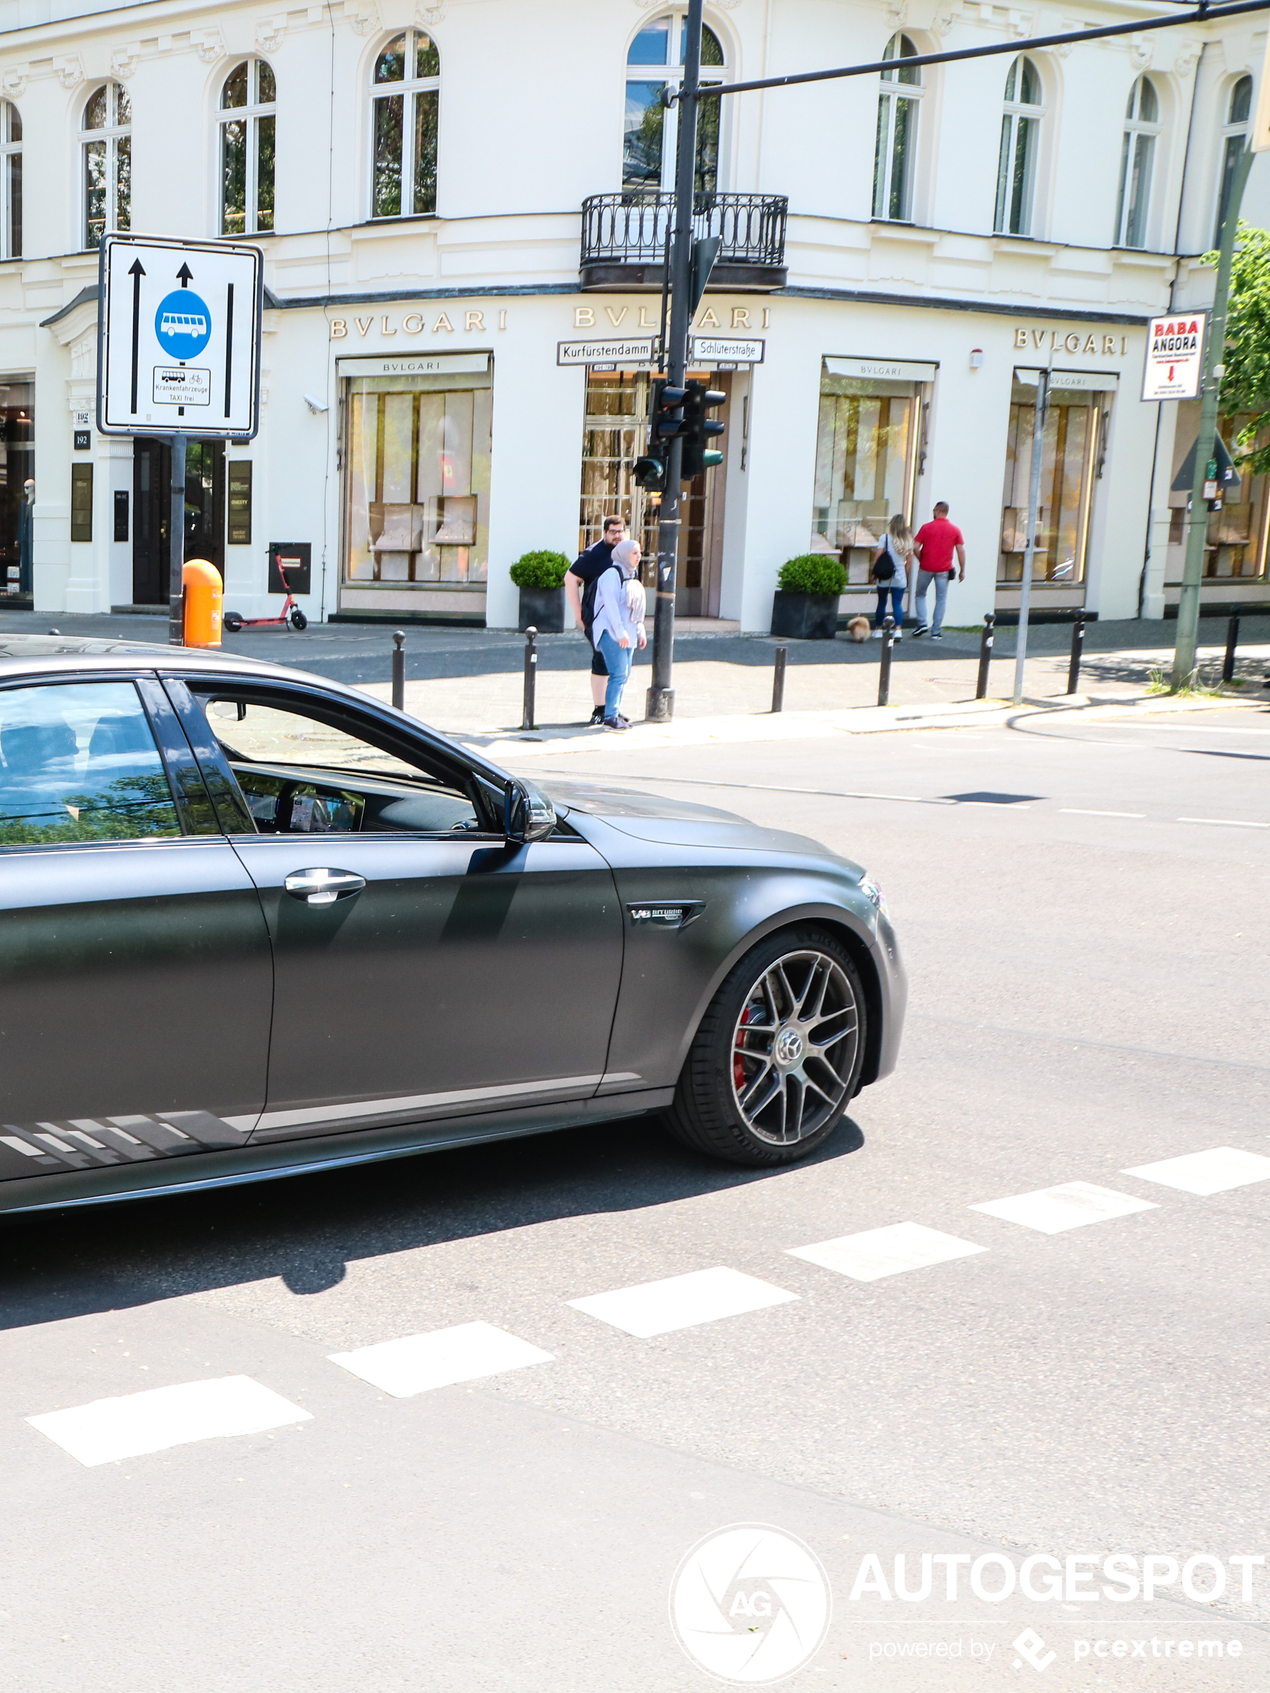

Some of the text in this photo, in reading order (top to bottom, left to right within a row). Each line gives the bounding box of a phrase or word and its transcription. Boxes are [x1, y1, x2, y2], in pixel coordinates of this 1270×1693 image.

[331, 309, 507, 338] BVLGARI
[573, 307, 770, 329] BVLARI
[1155, 320, 1198, 337] BABA
[700, 341, 756, 356] Schlüterstraße
[1014, 328, 1128, 355] BVLGARI
[1152, 335, 1197, 352] ANGORA
[563, 343, 649, 358] Kurfürstendamm
[382, 362, 440, 371] BVLGARI
[859, 366, 901, 376] BVLGARI
[155, 384, 208, 394] Krankenfahrzeuge
[77, 412, 89, 420] 192
[77, 436, 88, 444] 192
[631, 909, 652, 919] V8
[731, 1127, 779, 1161] MICHELIN
